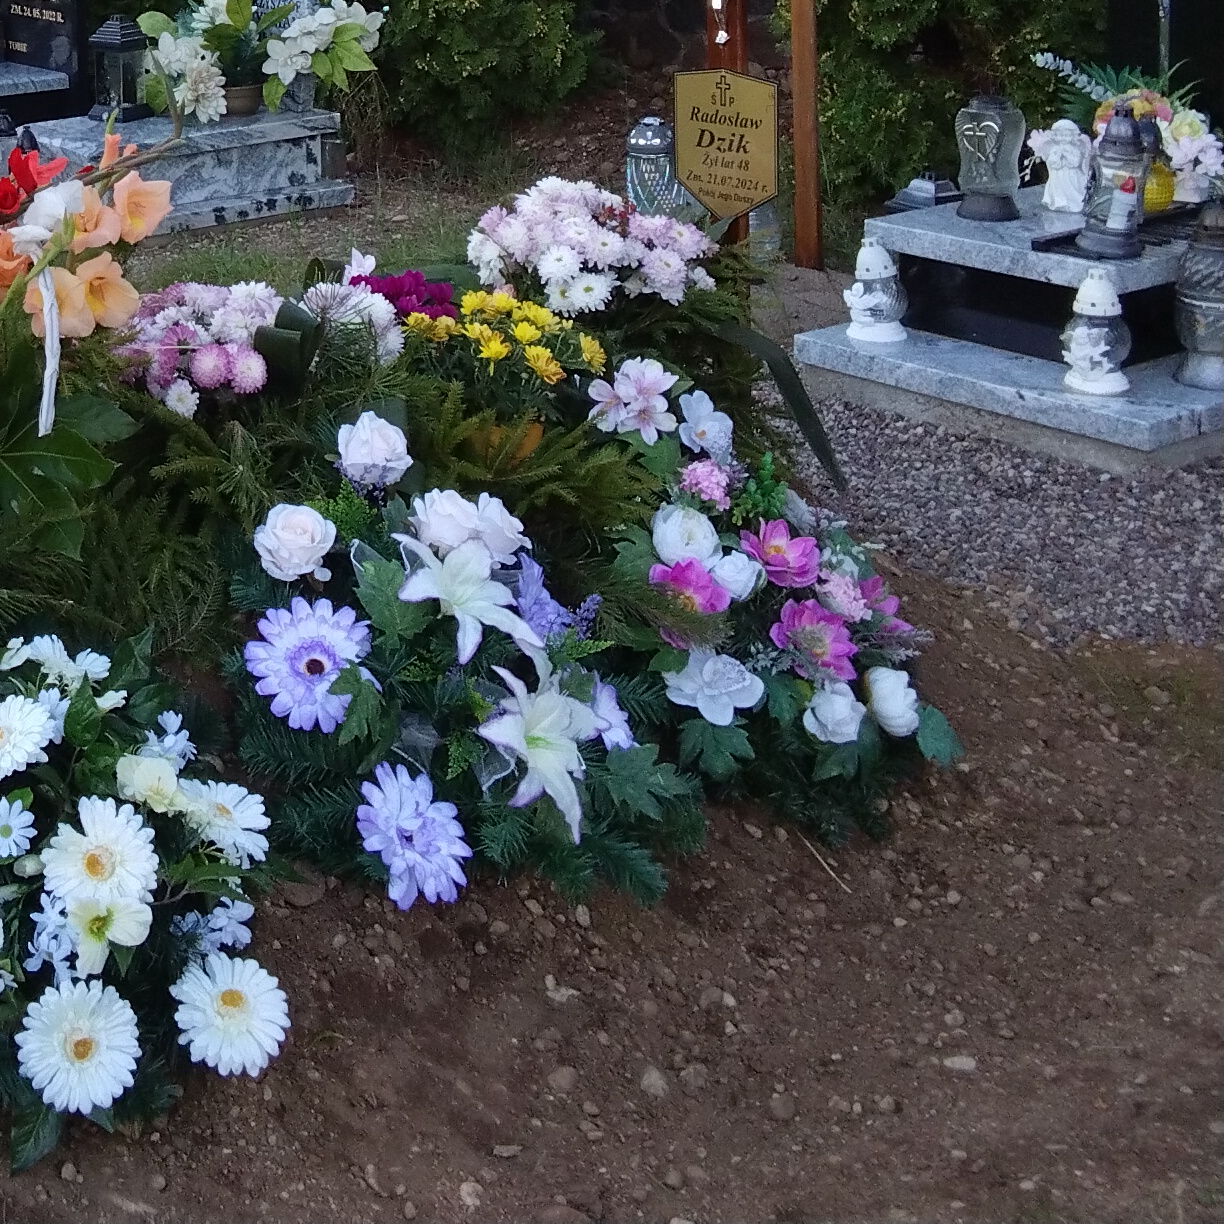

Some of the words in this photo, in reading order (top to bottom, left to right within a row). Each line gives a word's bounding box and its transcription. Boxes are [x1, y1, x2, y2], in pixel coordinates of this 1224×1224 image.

[689, 106, 763, 130] Radosław
[695, 128, 752, 154] Dzik
[701, 151, 718, 169] Żył
[720, 154, 735, 170] lat
[736, 158, 750, 172] 48
[686, 169, 704, 183] Zm.
[706, 172, 759, 192] 21.07.2024
[761, 184, 768, 193] r.
